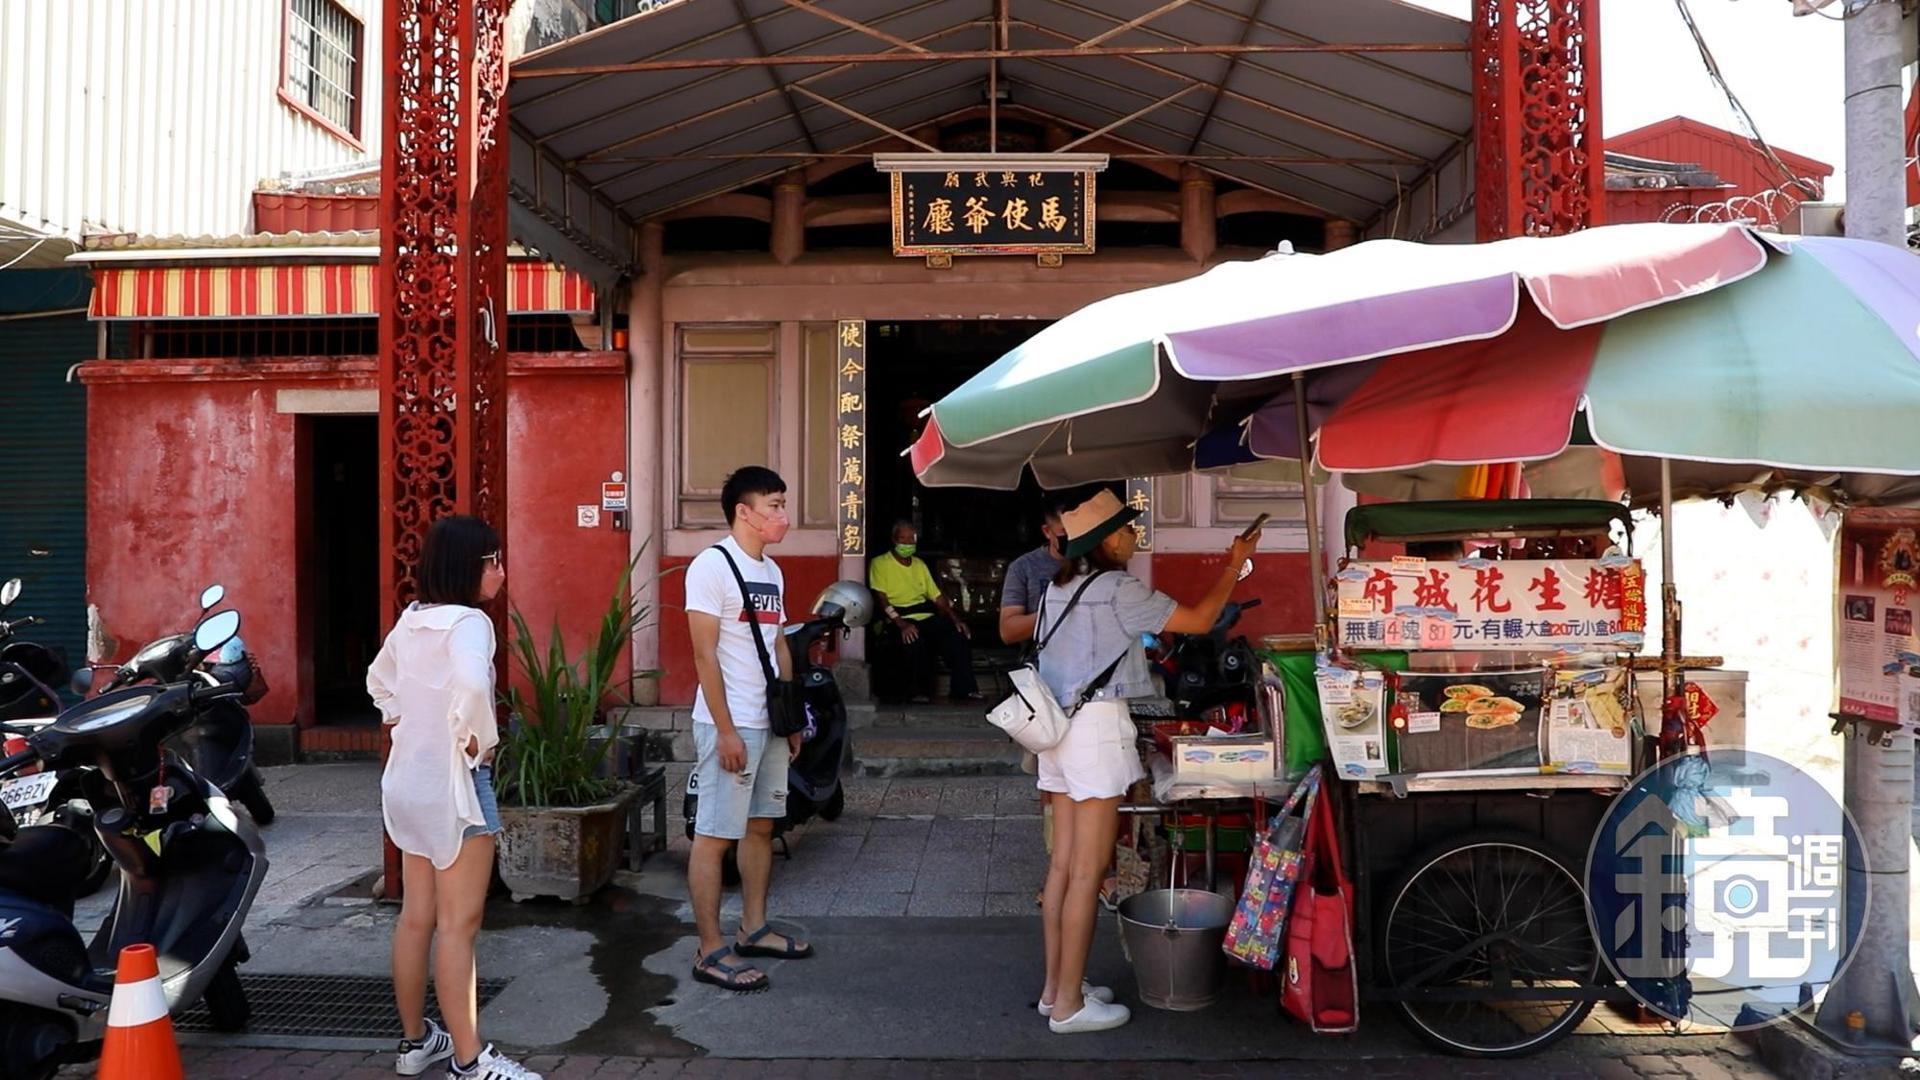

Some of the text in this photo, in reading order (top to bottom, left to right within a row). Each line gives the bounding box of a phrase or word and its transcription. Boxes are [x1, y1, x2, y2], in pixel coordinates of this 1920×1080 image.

[922, 196, 1067, 234] 馬使爺廳
[1362, 567, 1622, 615] 府城花生糖
